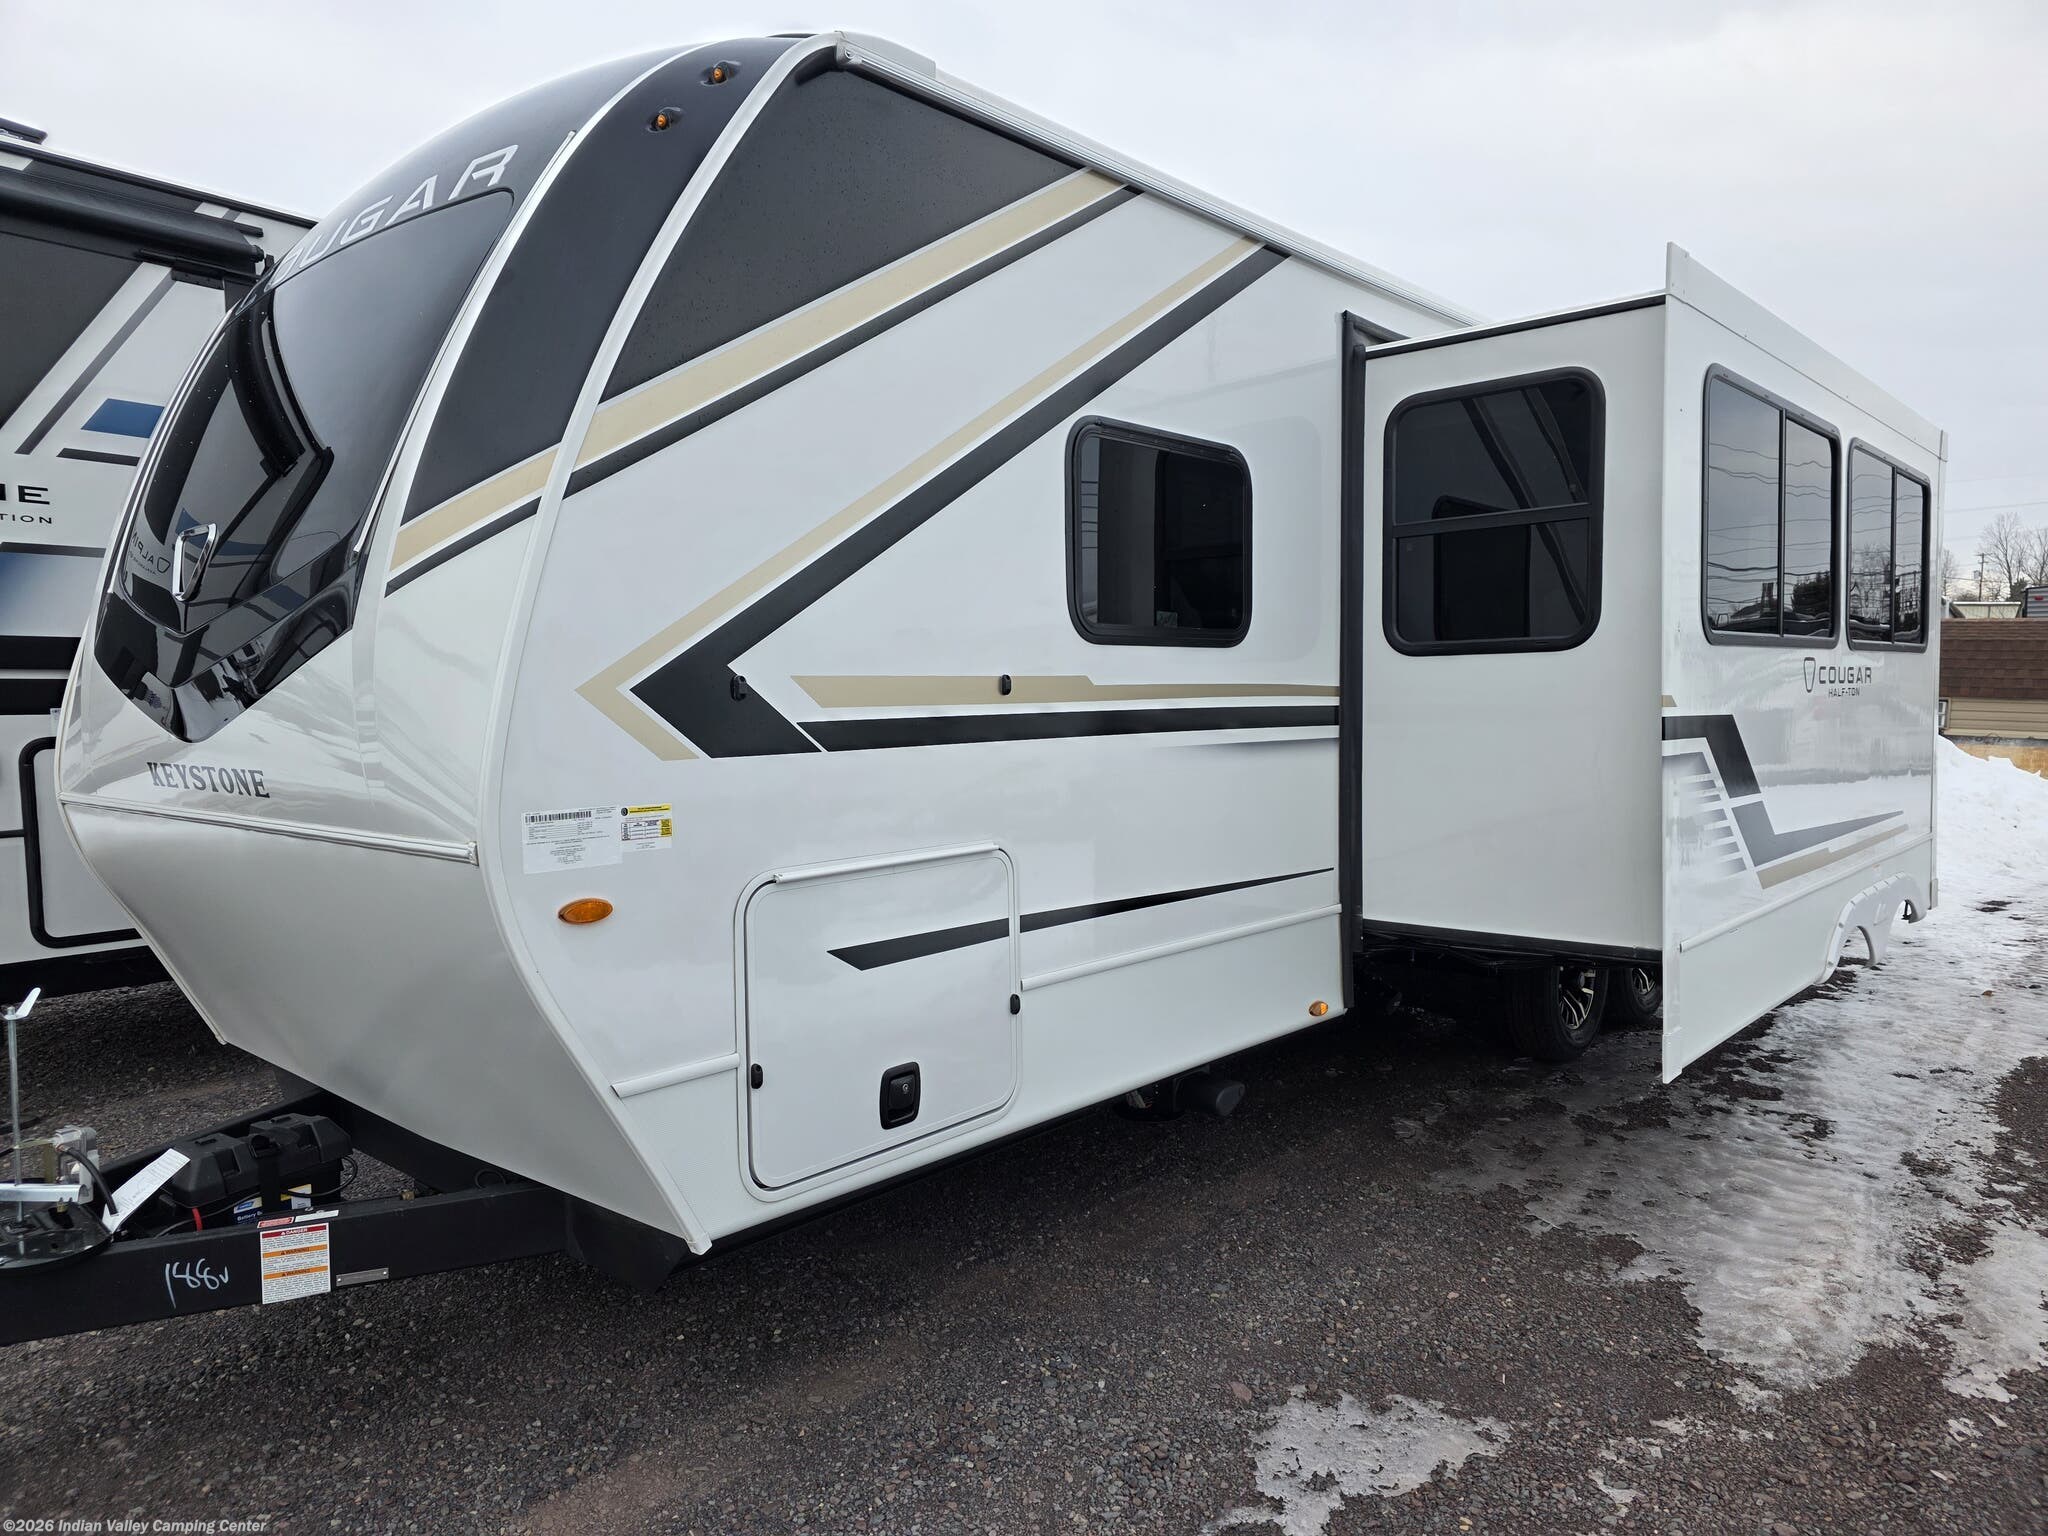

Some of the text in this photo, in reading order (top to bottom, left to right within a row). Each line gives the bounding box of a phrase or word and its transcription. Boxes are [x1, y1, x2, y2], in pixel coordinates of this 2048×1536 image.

[1818, 666, 1872, 684] COUGAR
[1828, 687, 1861, 697] HALF-TON
[146, 761, 271, 799] KEYSTONE
